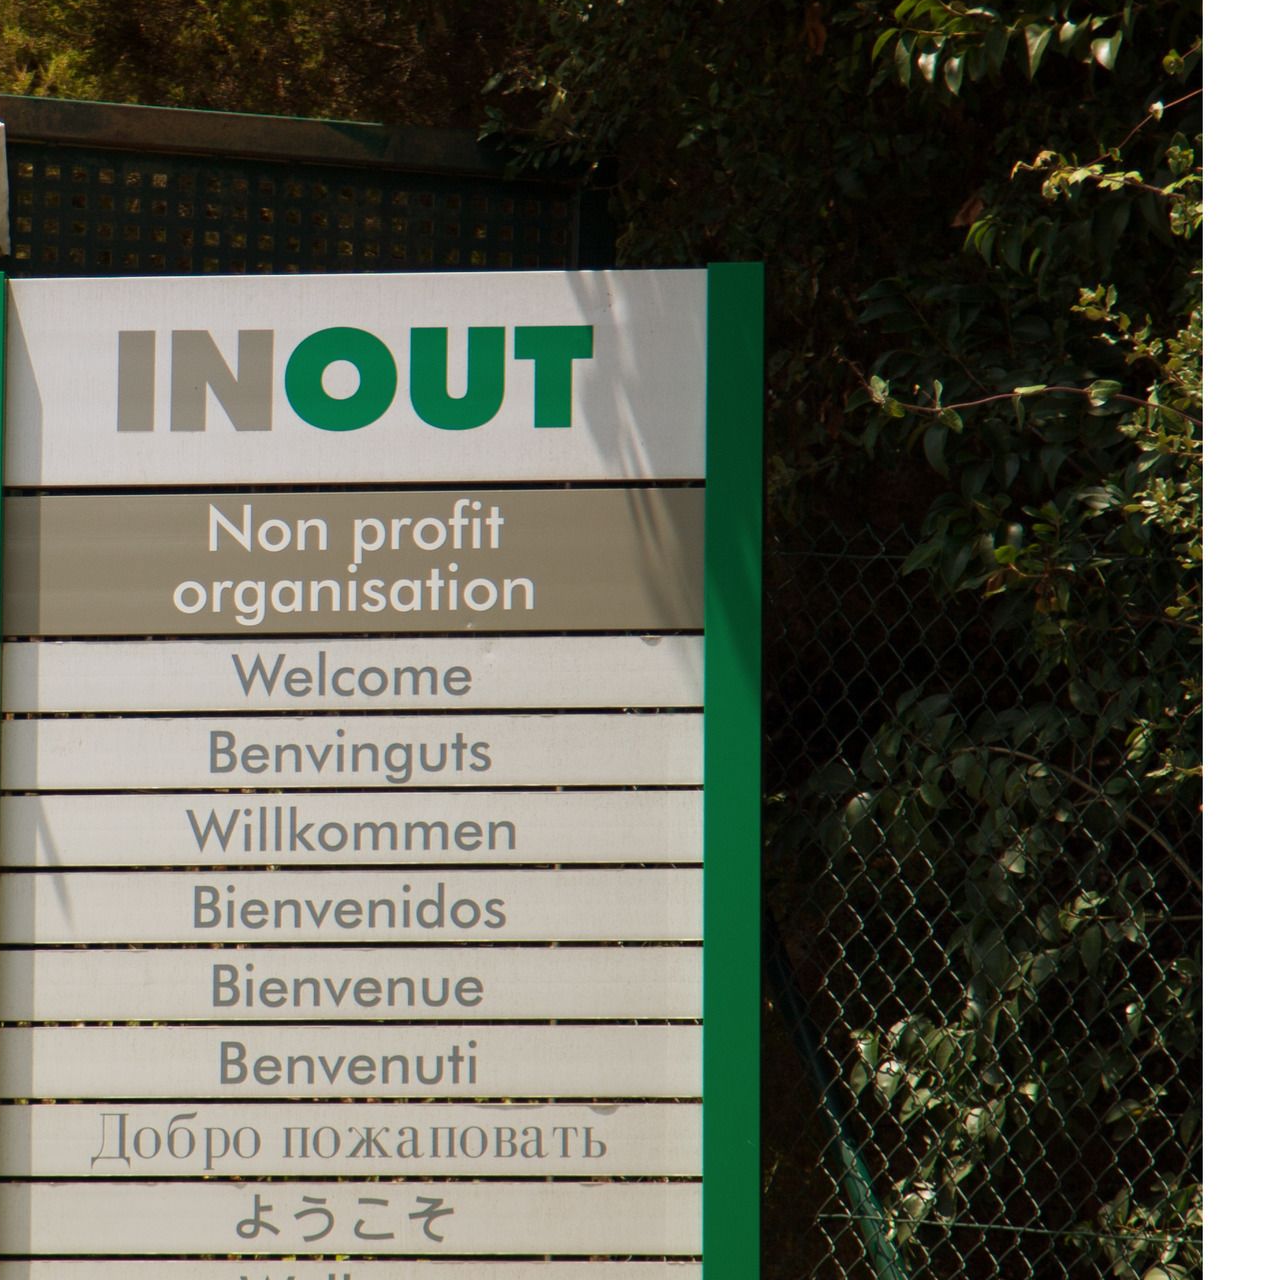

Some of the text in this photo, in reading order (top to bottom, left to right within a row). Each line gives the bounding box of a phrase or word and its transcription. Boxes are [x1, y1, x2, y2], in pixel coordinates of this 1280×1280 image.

[116, 325, 594, 432] INOUT
[209, 499, 504, 564] Non profit
[173, 564, 535, 624] organisation
[232, 651, 472, 697] Welcome
[209, 728, 493, 783] Benvinguts
[186, 807, 515, 852] Willkommen
[194, 883, 506, 929] Bienvenidos
[213, 964, 483, 1007] Bienvenue
[221, 1040, 477, 1085] Benvenuti
[91, 1111, 261, 1170] Добро
[236, 1194, 454, 1242] ようこそ
